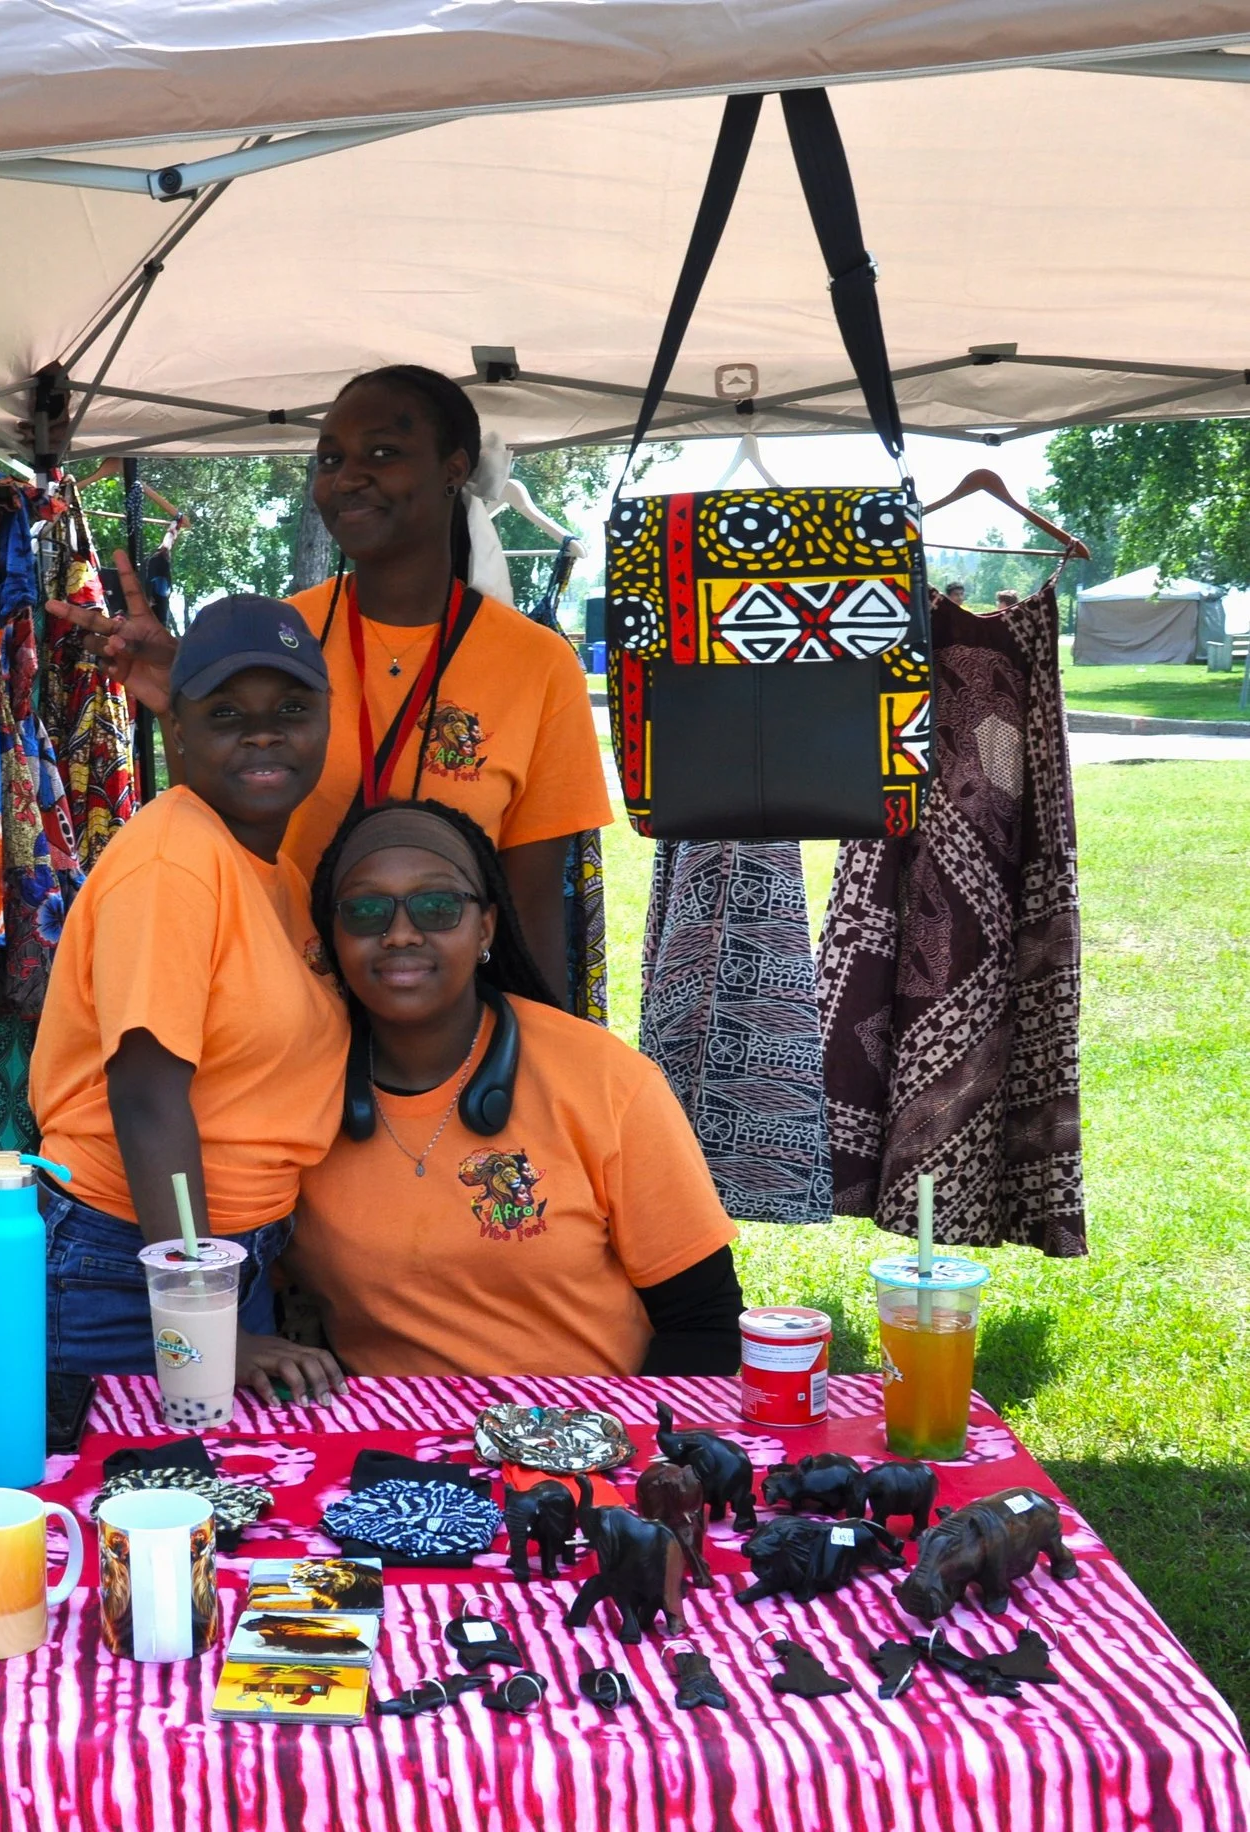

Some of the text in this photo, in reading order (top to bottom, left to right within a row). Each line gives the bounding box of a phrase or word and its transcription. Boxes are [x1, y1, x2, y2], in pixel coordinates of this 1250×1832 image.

[435, 748, 474, 765] Afro
[491, 1202, 534, 1223] Afro
[480, 1218, 548, 1242] Vibe Fest
